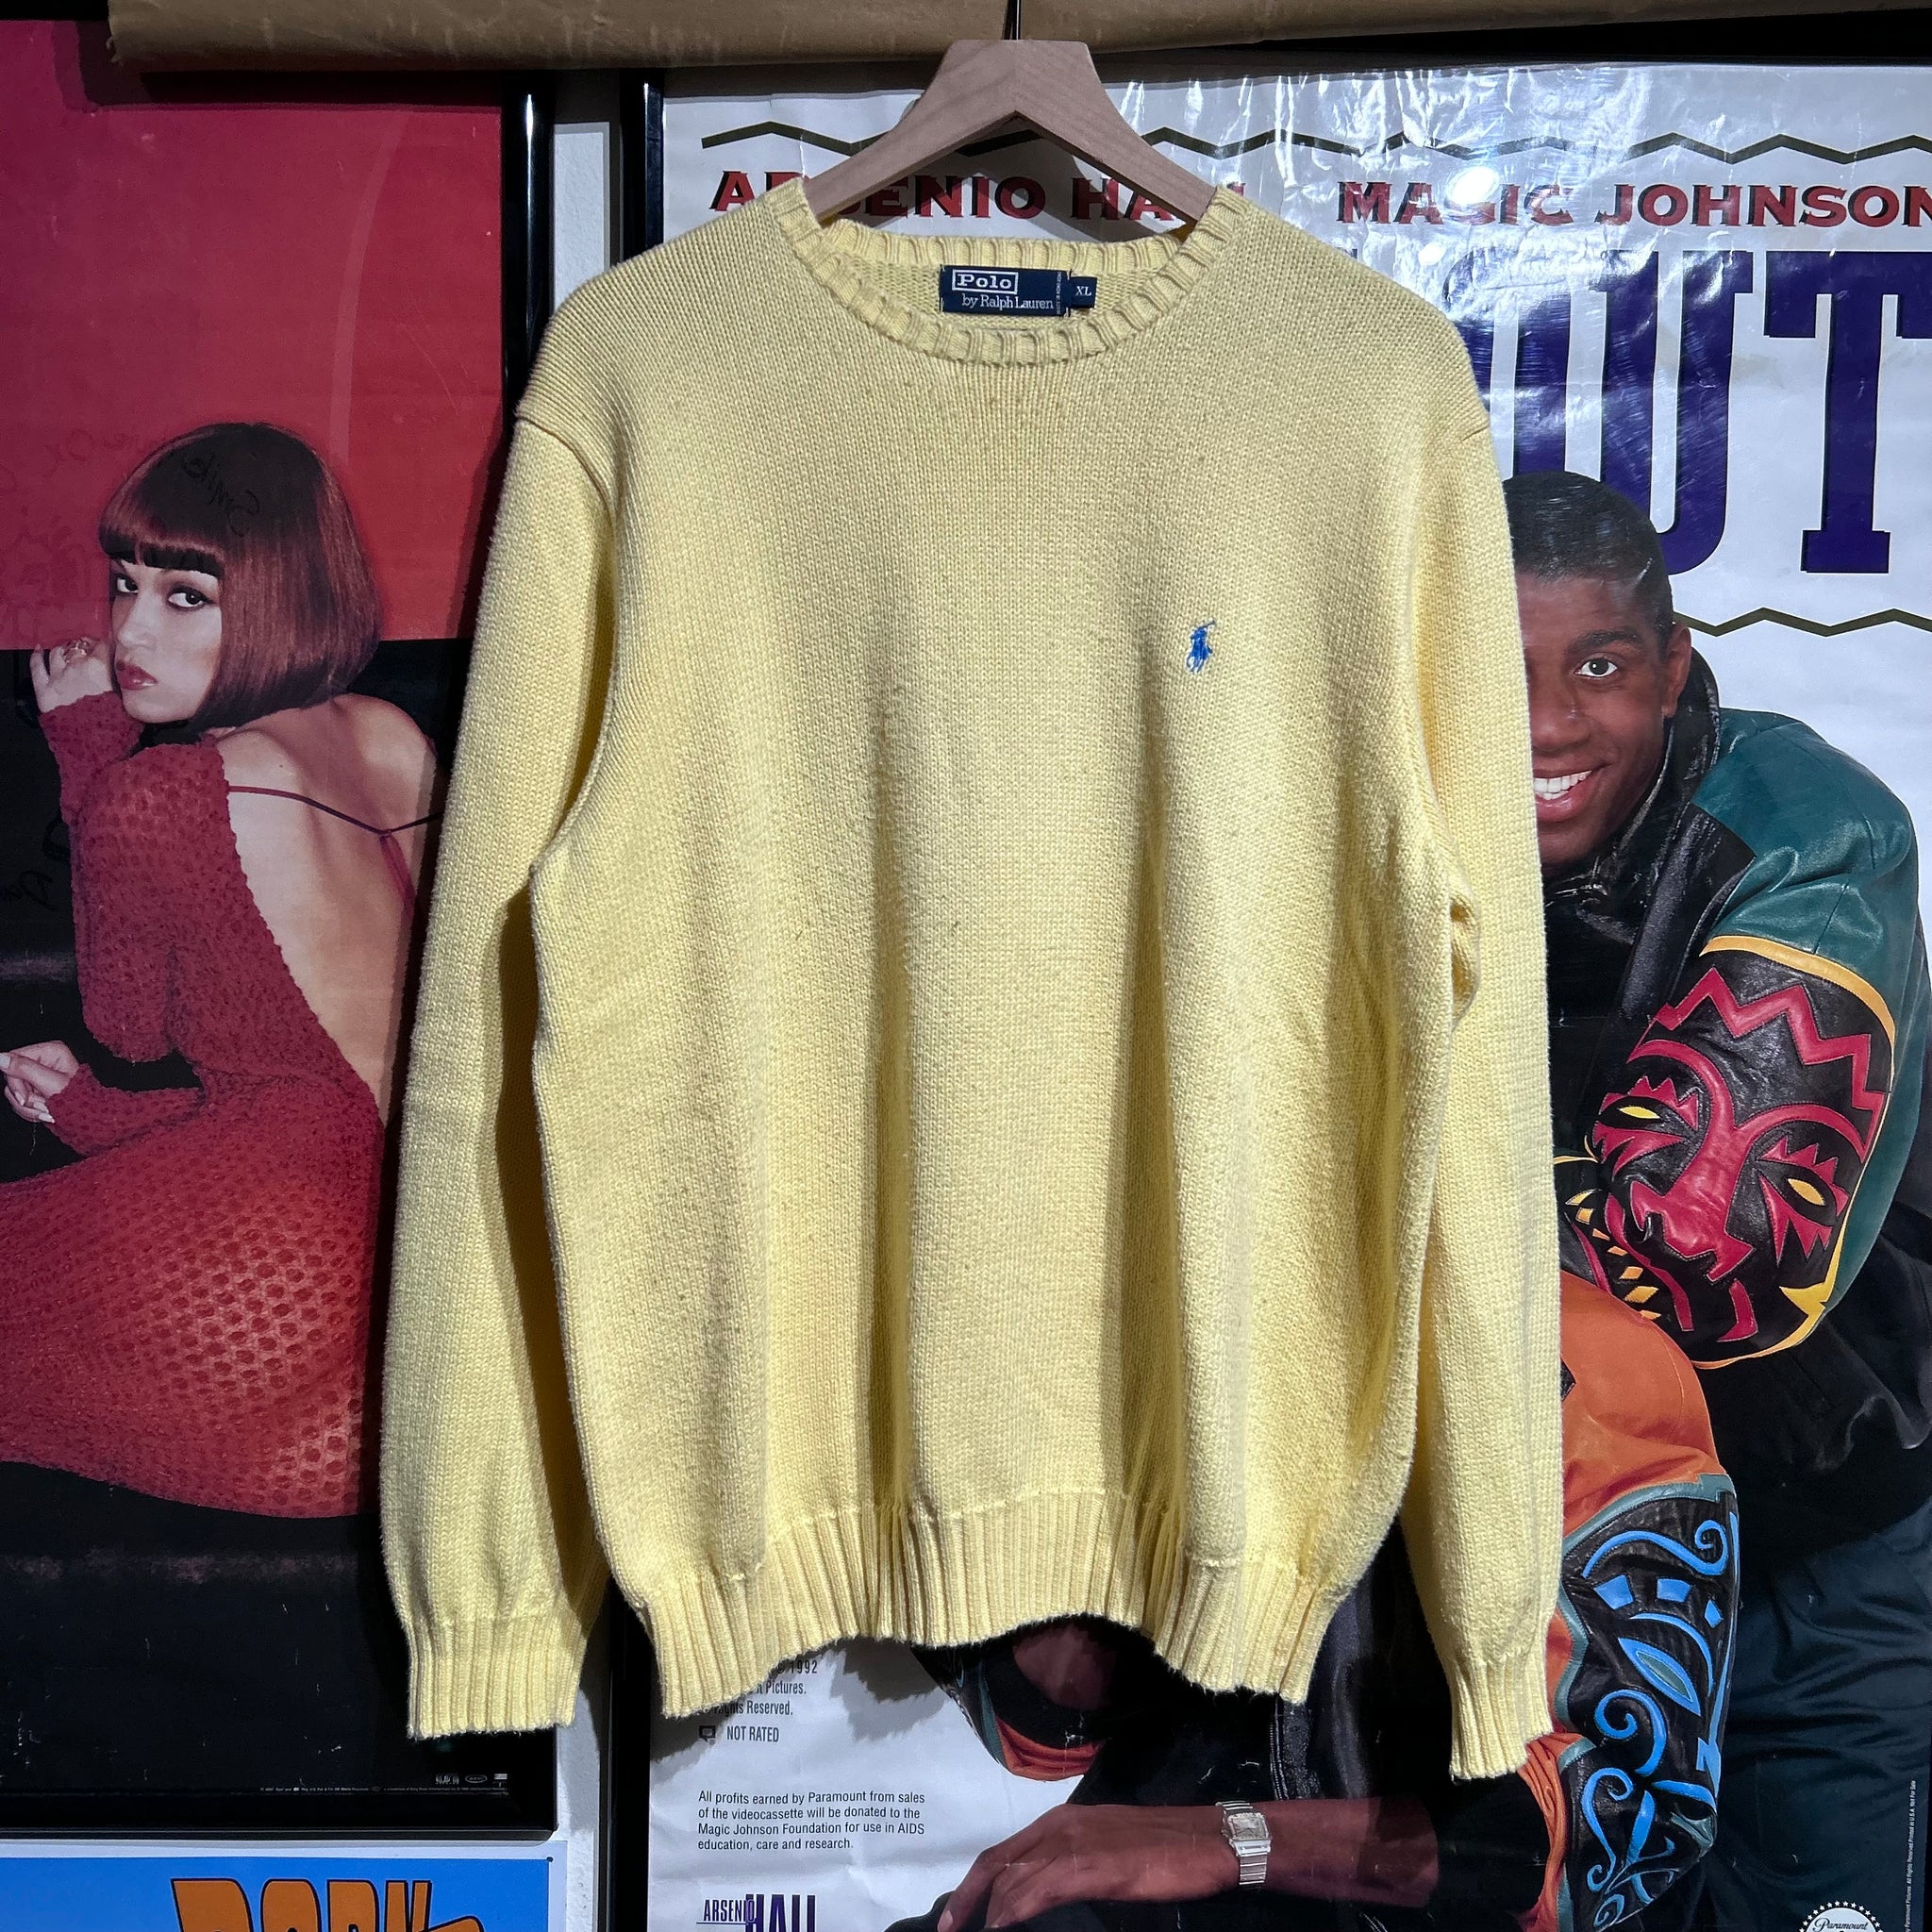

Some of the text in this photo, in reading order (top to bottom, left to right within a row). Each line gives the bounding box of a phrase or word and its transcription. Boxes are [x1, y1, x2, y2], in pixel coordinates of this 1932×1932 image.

[709, 170, 1045, 220] AENIO
[957, 273, 1012, 290] Polo
[1074, 285, 1092, 297] XL
[961, 293, 1055, 311] by Ralph Lauren
[791, 1659, 818, 1674] 1992
[765, 1679, 807, 1695] Pictures.
[746, 1700, 793, 1716] Reserved.
[726, 1725, 779, 1742] NOT RATED
[698, 1790, 925, 1806] All profits earned by Paramount from sales
[698, 1807, 921, 1820] of the videocassette will be donated to the
[698, 1821, 925, 1837] Magic Johnson Foundation for use in AIDS
[697, 1838, 854, 1852] education, care and research.
[703, 1899, 755, 1923] ARSENIO
[1812, 1917, 1869, 1932] Paramount
